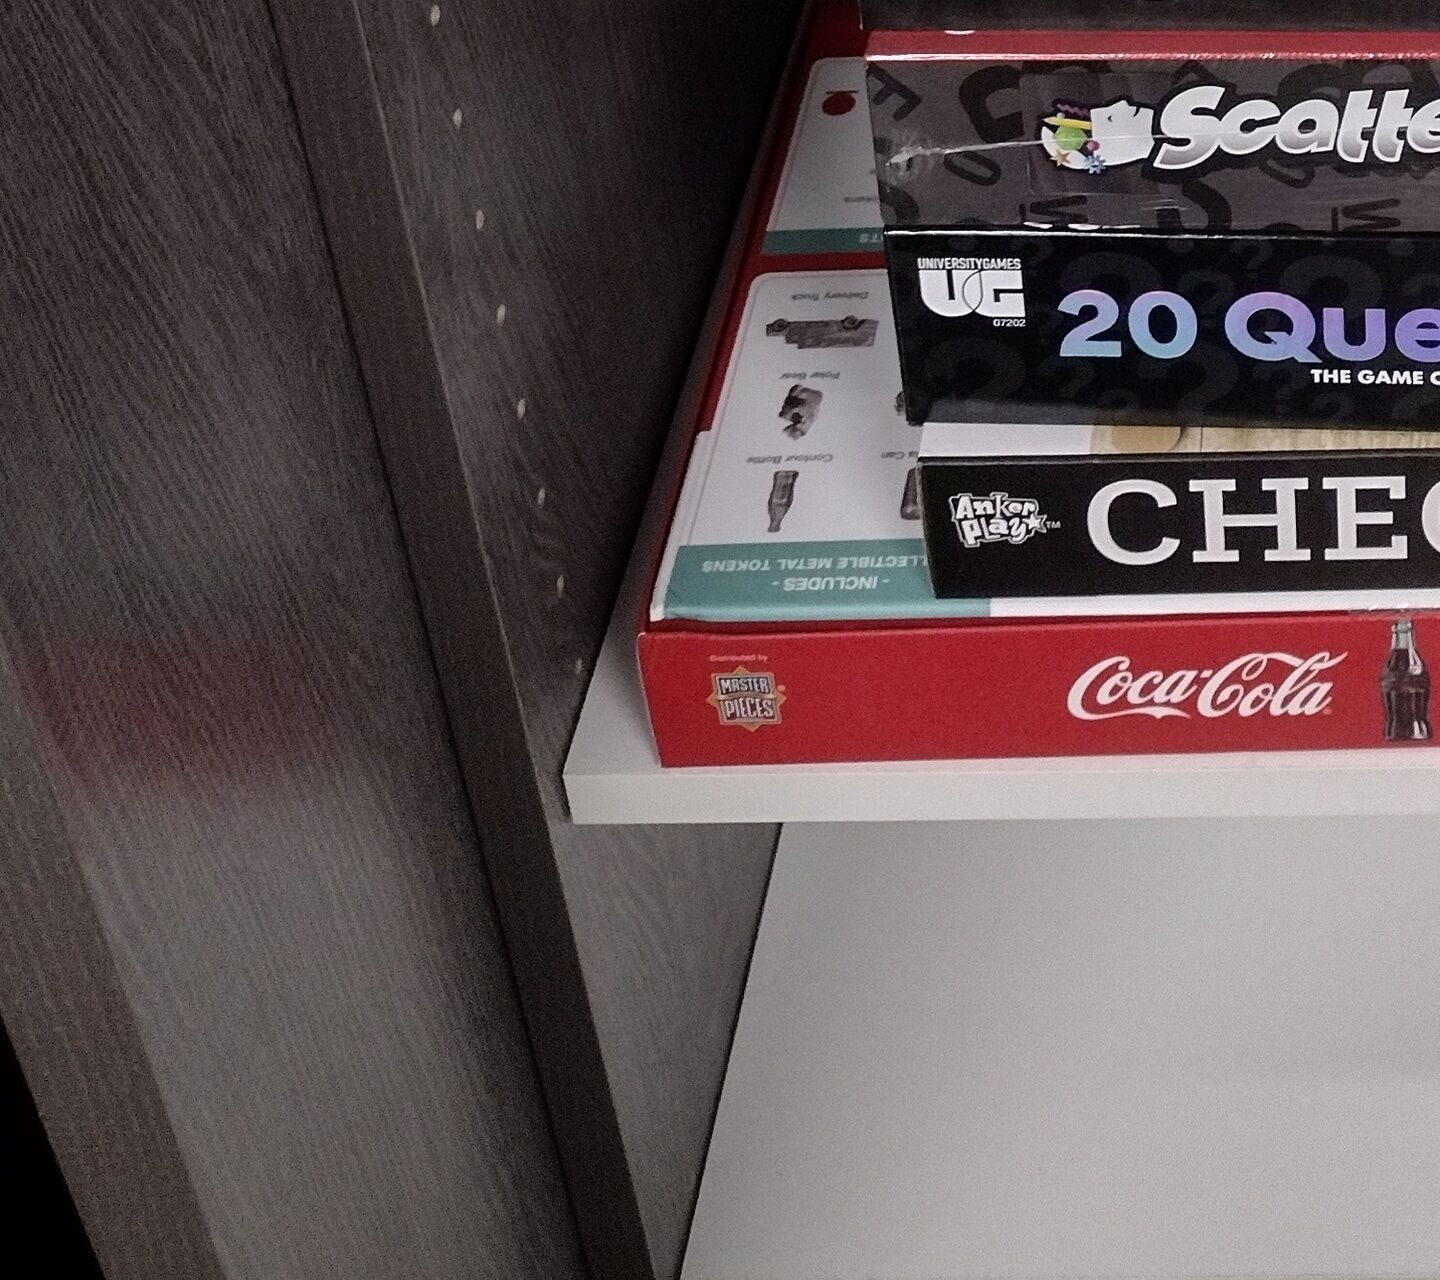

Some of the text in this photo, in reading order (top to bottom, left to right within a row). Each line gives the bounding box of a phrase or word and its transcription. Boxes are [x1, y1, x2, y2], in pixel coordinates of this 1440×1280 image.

[992, 318, 1026, 328] 07202
[1057, 288, 1198, 360] 20
[1310, 368, 1351, 385] THE
[1357, 369, 1425, 386] GAME
[955, 493, 1036, 520] Anker
[702, 559, 770, 573] TOKENS
[776, 557, 833, 571] METAL
[783, 576, 879, 591] INCLUDES
[719, 677, 769, 695] MASTER
[1067, 651, 1349, 721] Coca-Cola
[724, 697, 774, 719] PIECES
